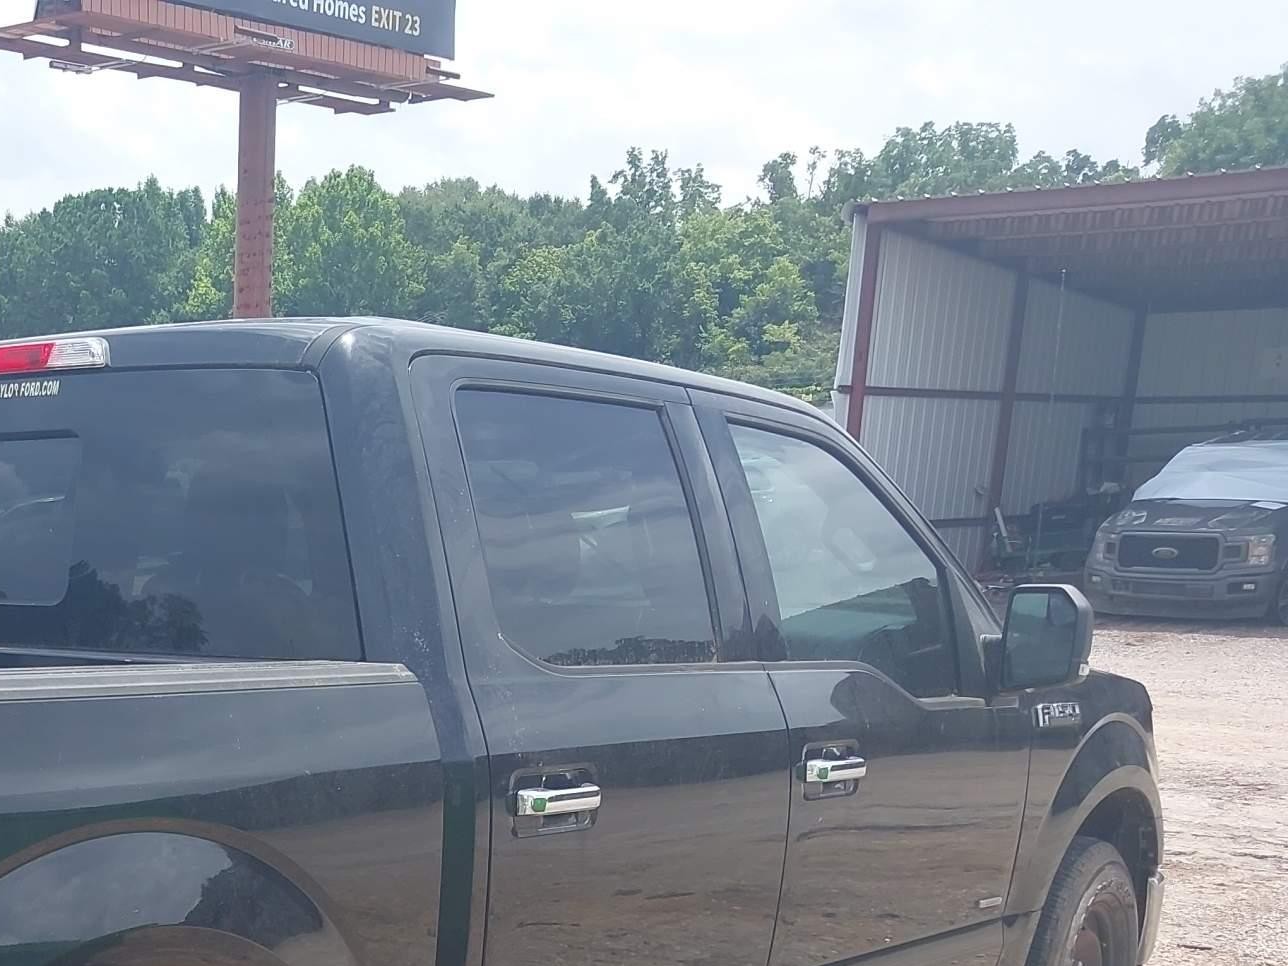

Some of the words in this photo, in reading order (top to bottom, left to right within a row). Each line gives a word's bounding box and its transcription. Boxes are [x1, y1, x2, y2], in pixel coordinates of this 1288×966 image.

[313, 0, 366, 24] Homes
[371, 5, 402, 32] EXIT
[404, 13, 420, 36] 23
[20, 380, 61, 397] FORD.COM
